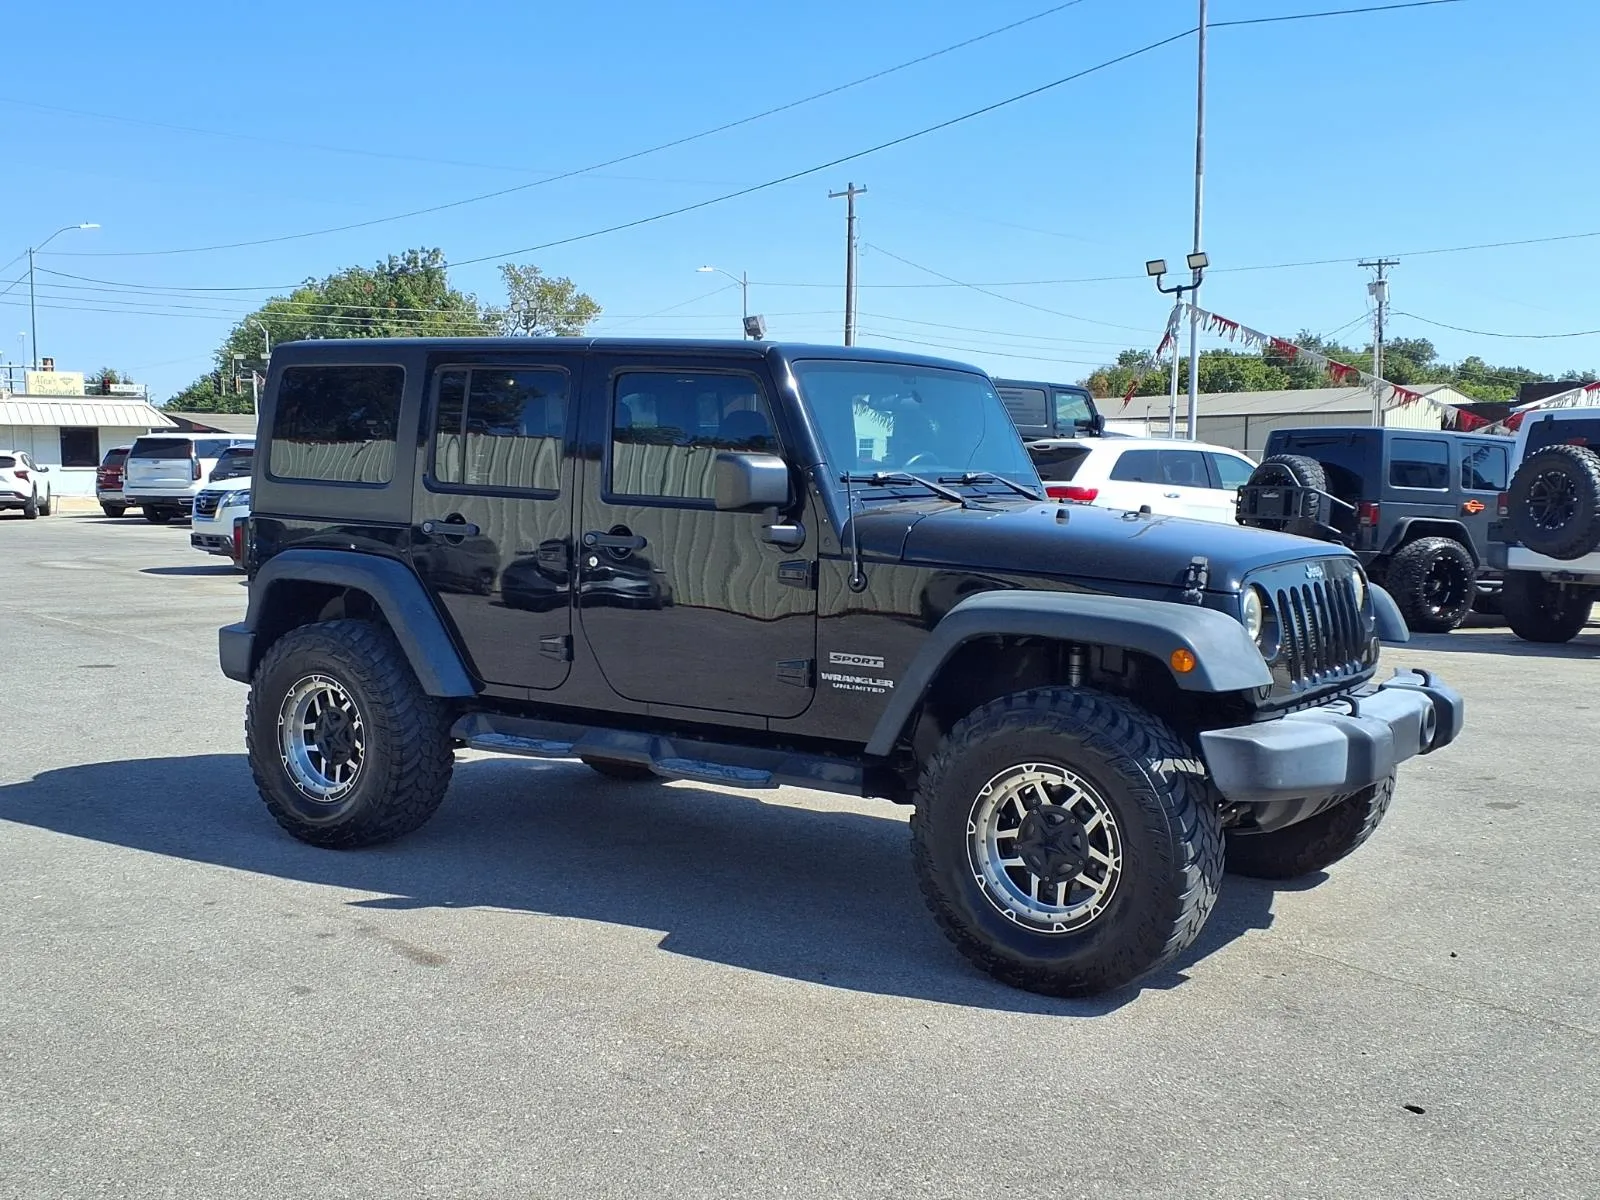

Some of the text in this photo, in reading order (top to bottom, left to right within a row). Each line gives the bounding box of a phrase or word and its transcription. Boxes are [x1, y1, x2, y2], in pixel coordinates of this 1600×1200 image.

[1305, 563, 1323, 580] Jeep
[831, 654, 883, 667] SPORT
[821, 672, 894, 688] WRANGLER
[832, 682, 885, 693] UNLIMITED
